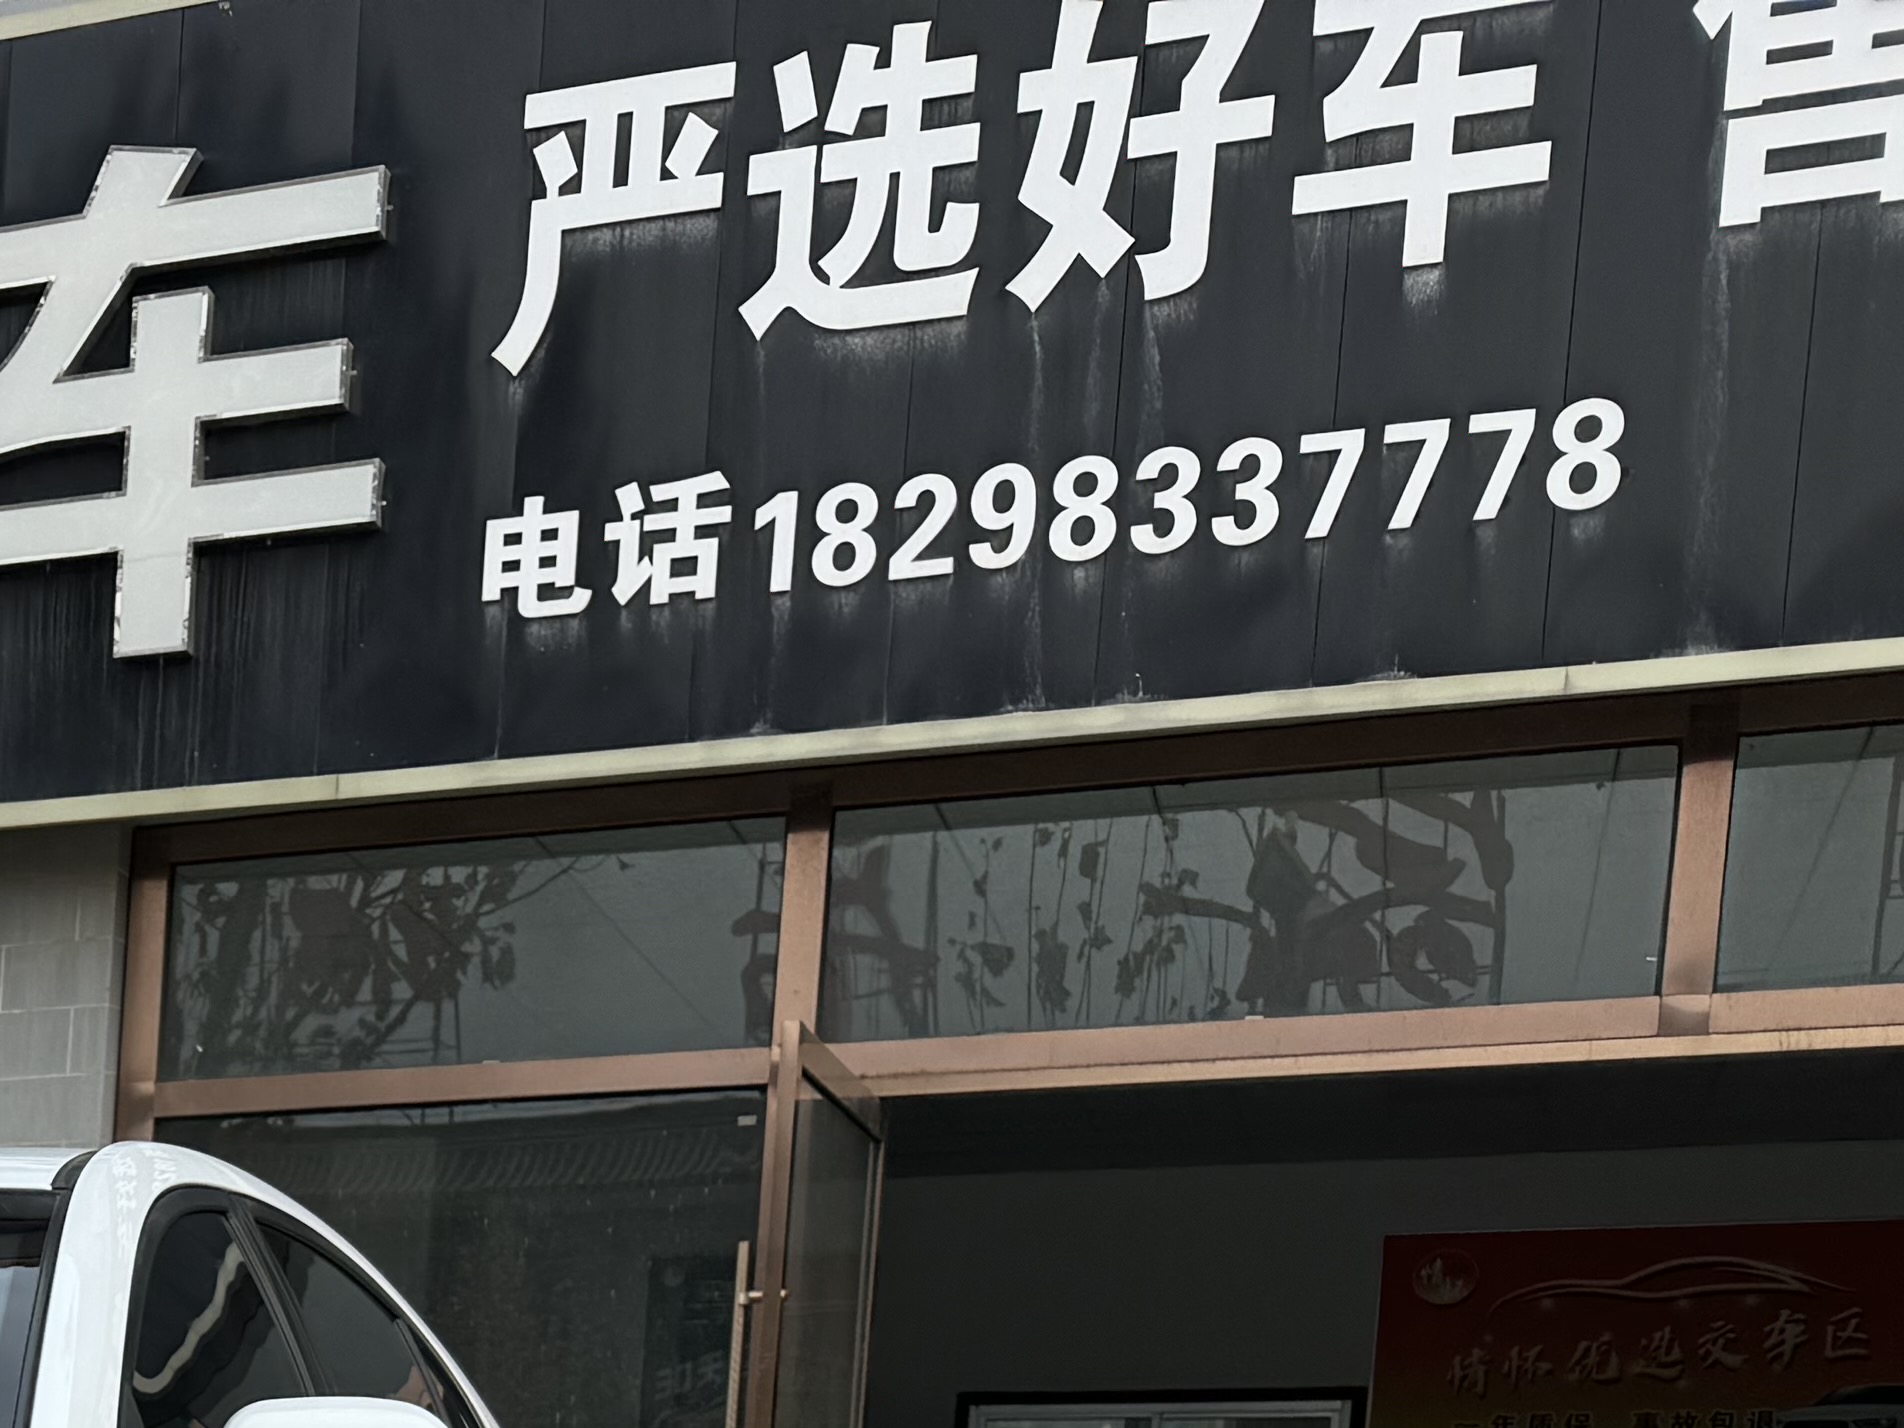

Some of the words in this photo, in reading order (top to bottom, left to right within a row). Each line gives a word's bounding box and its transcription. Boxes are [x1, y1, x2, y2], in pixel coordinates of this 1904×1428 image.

[1446, 1305, 1873, 1398] 情怀优选交车区
